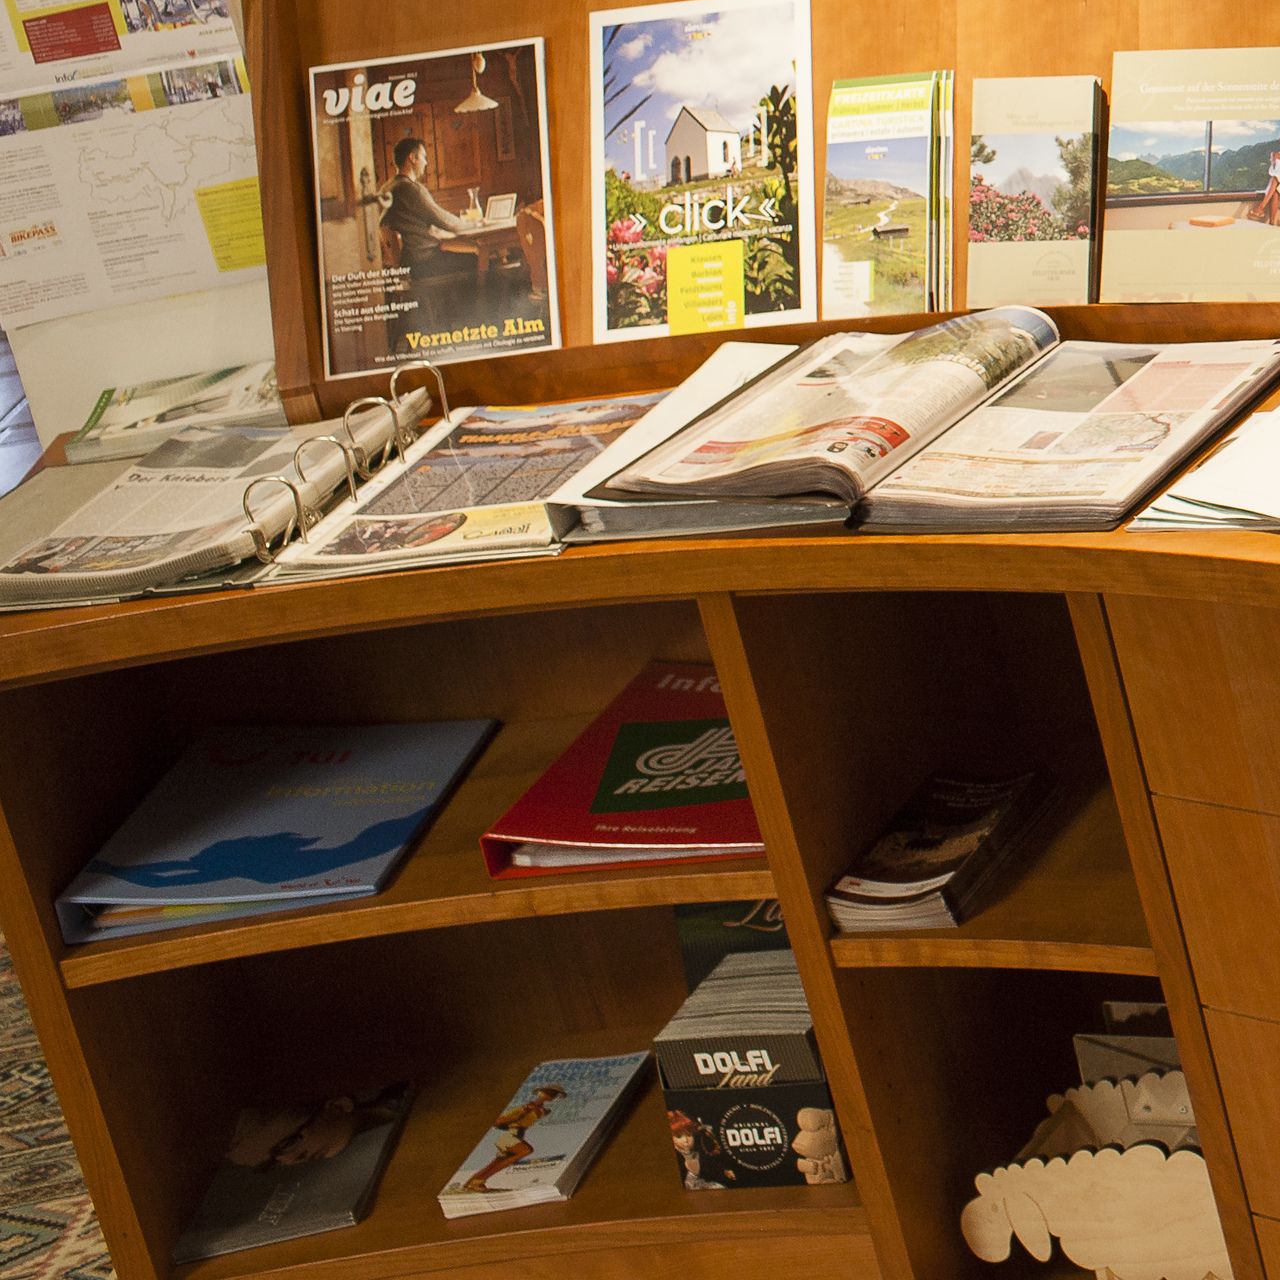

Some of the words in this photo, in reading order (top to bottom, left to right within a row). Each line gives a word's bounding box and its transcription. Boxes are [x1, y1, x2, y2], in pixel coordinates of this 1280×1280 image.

[322, 73, 417, 117] viae
[659, 185, 751, 235] click
[405, 323, 498, 351] Vernetzte
[502, 318, 545, 337] Alm
[693, 1049, 774, 1075] DOLFI
[725, 1126, 783, 1147] DOLFI
